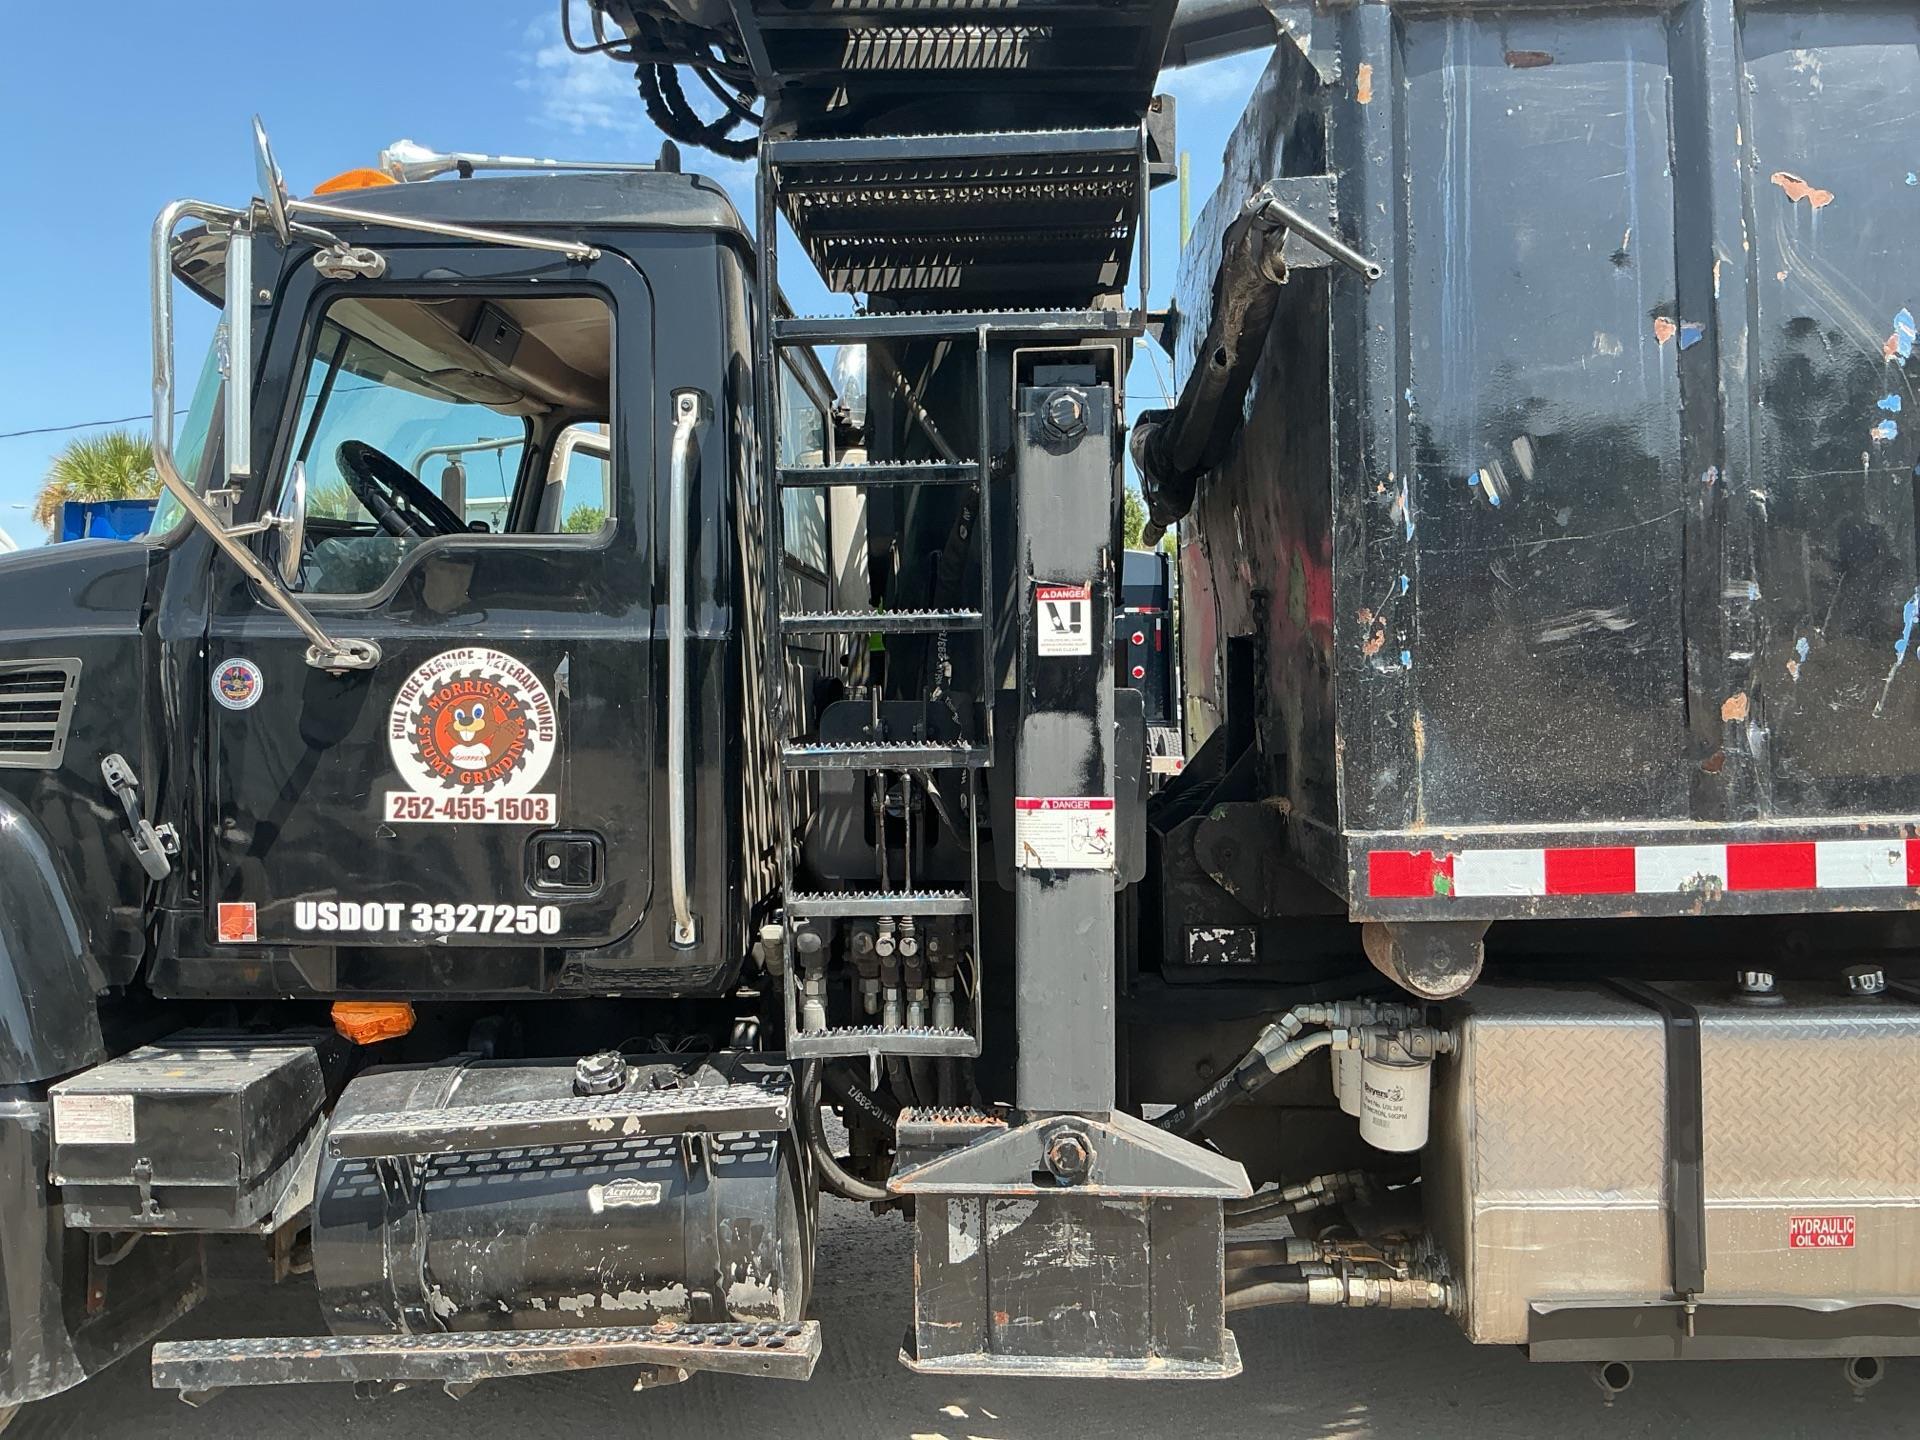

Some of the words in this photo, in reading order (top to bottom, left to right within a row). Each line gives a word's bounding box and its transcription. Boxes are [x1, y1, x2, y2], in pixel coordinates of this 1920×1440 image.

[396, 672, 425, 708] TREE
[427, 680, 519, 712] MORRISSEY
[392, 710, 408, 740] FULL
[531, 691, 554, 742] OWNED
[418, 727, 454, 777] STUMP
[460, 728, 527, 784] GRINDING
[393, 796, 549, 821] 252-455-1503
[1052, 801, 1090, 809] DANGER
[295, 901, 405, 932] USDOT
[411, 903, 561, 934] 3327250
[1791, 1217, 1854, 1234] HYDRAULIC
[1796, 1234, 1815, 1246] OIL
[1817, 1234, 1848, 1246] ONLY
